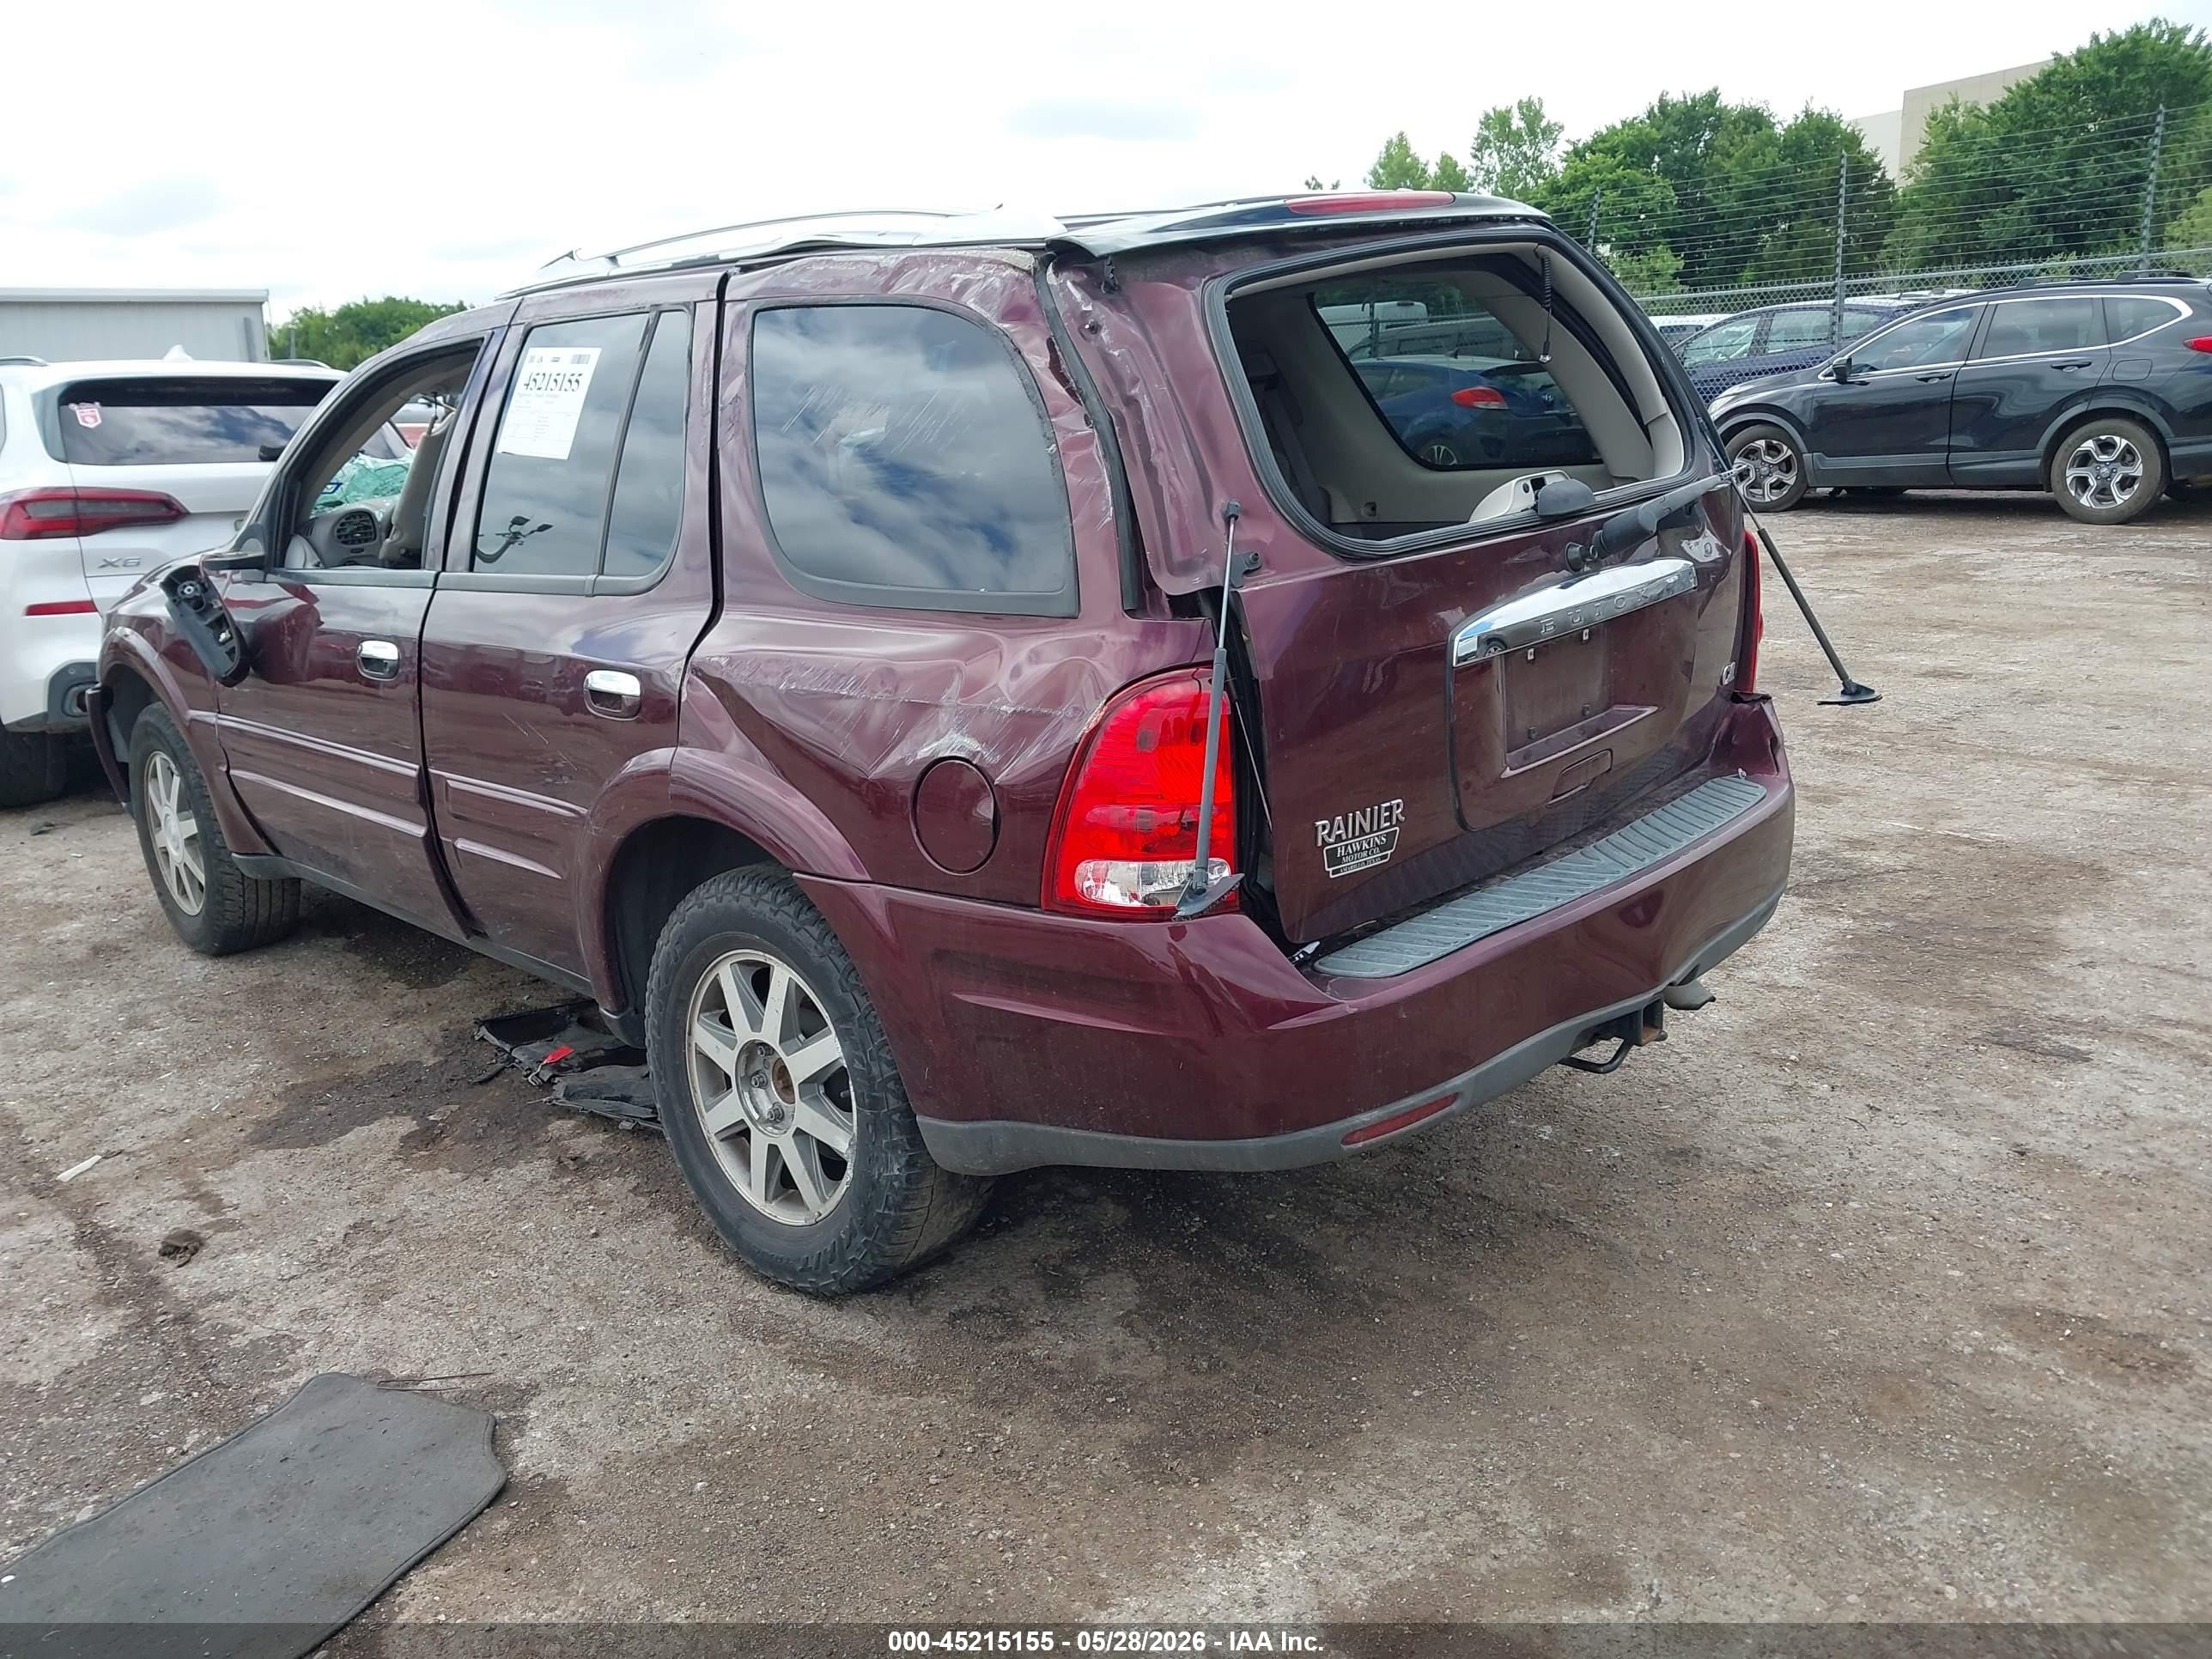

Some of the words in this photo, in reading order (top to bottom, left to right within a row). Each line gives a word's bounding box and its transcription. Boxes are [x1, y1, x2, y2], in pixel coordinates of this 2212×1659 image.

[523, 372, 583, 392] 45215155
[1540, 586, 1650, 634] BUICK
[1314, 799, 1406, 847] RAINIER
[1336, 834, 1387, 857] HAWKINS
[1341, 850, 1368, 864] MOTOR
[1369, 847, 1381, 856] CO.
[1366, 857, 1381, 866] TEXAS
